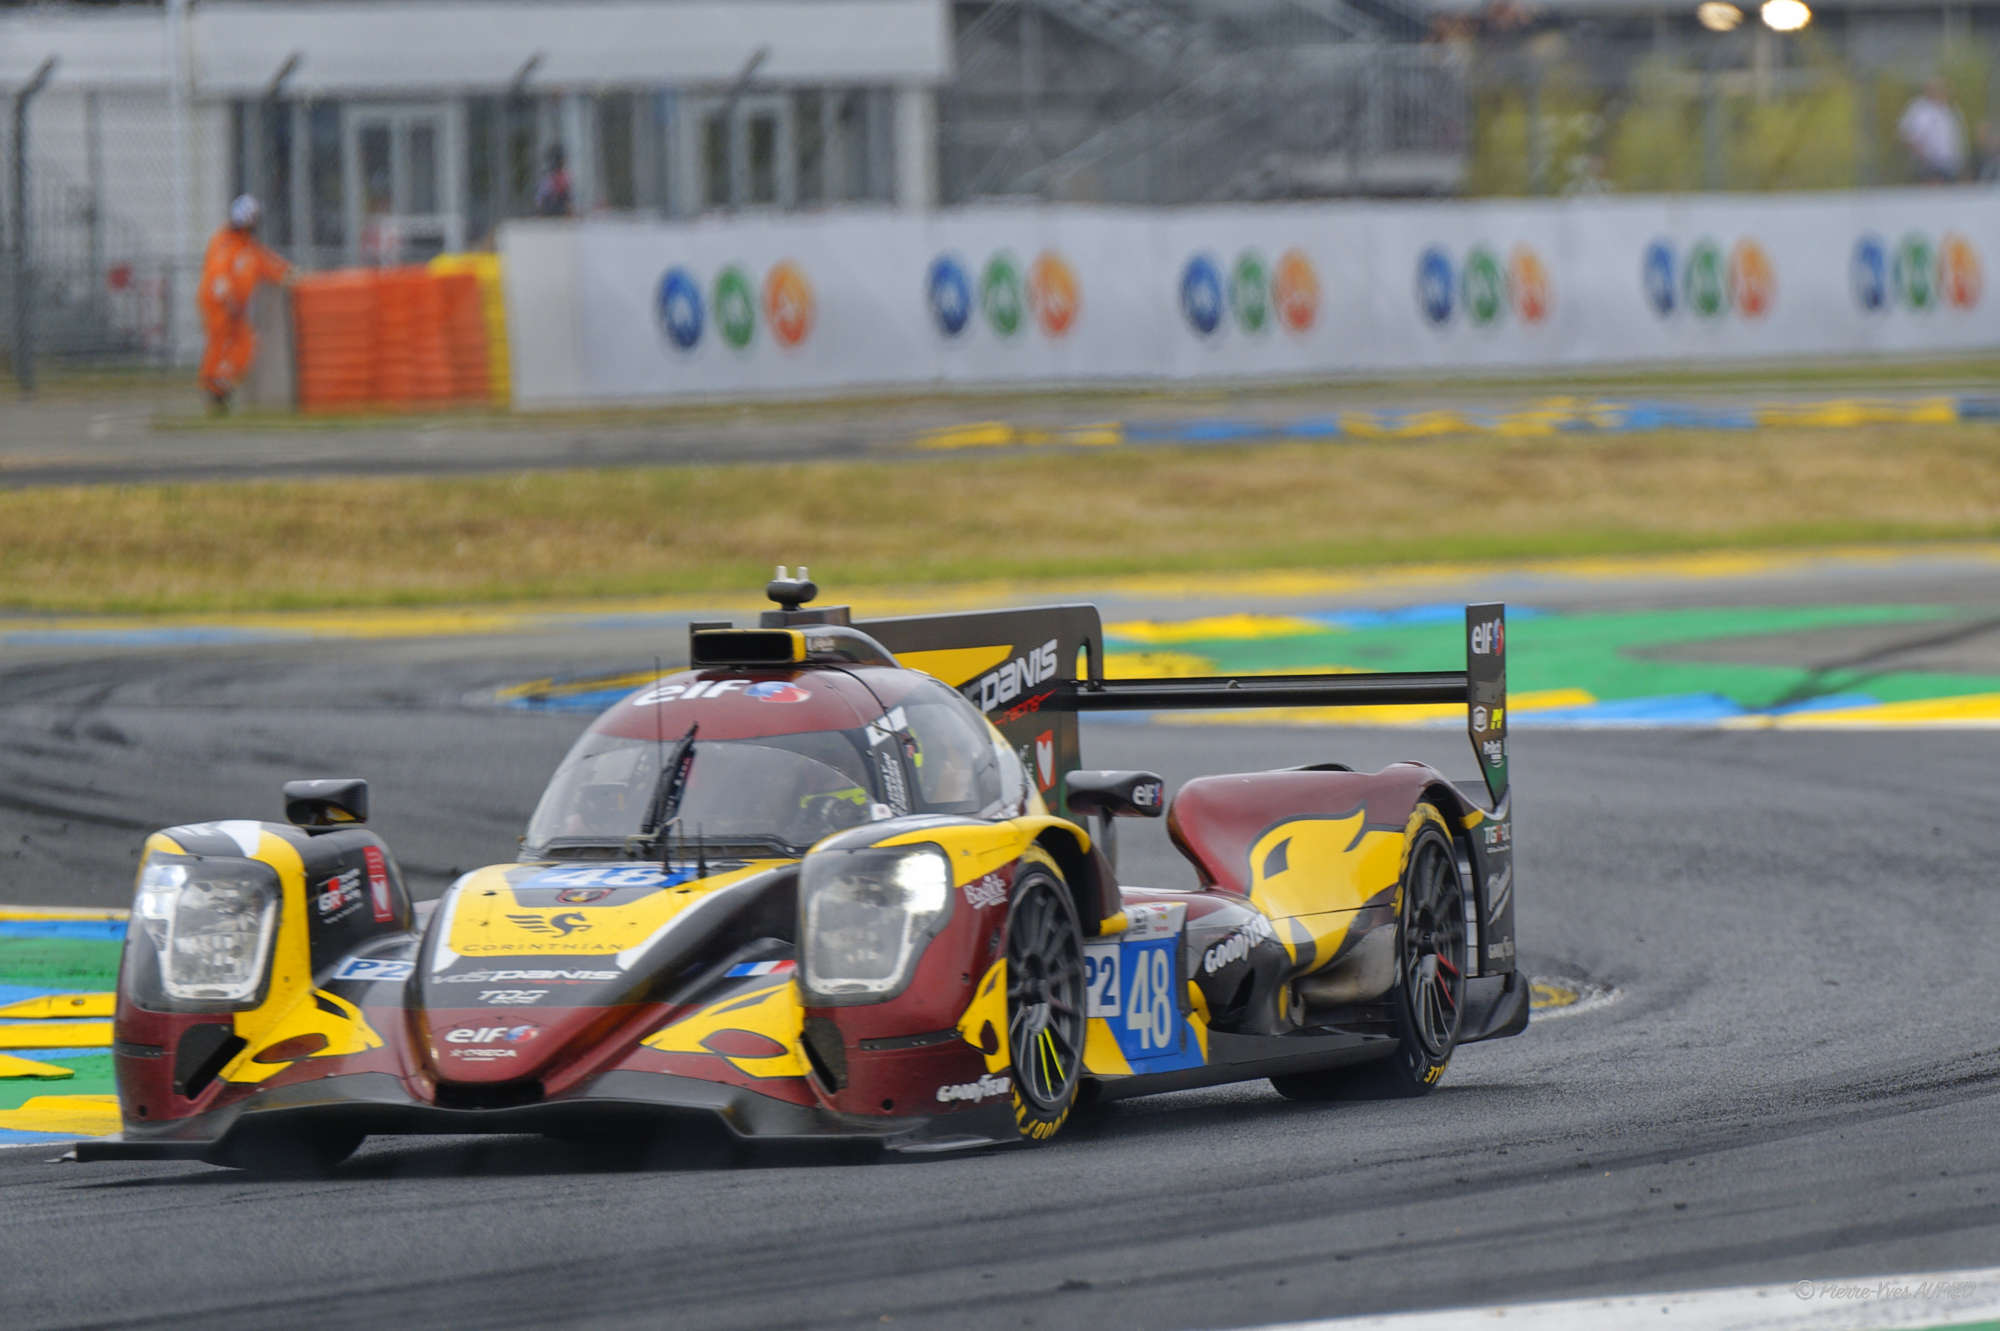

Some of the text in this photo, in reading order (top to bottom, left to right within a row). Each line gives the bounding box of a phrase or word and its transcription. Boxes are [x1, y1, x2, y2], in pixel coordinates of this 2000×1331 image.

[1471, 622, 1493, 655] elf
[632, 680, 752, 706] elf
[1132, 784, 1155, 806] elf
[539, 867, 680, 886] 48
[462, 943, 625, 951] CORINTHIAN
[341, 961, 414, 977] P2
[1126, 948, 1172, 1050] 48
[445, 1027, 510, 1043] elf
